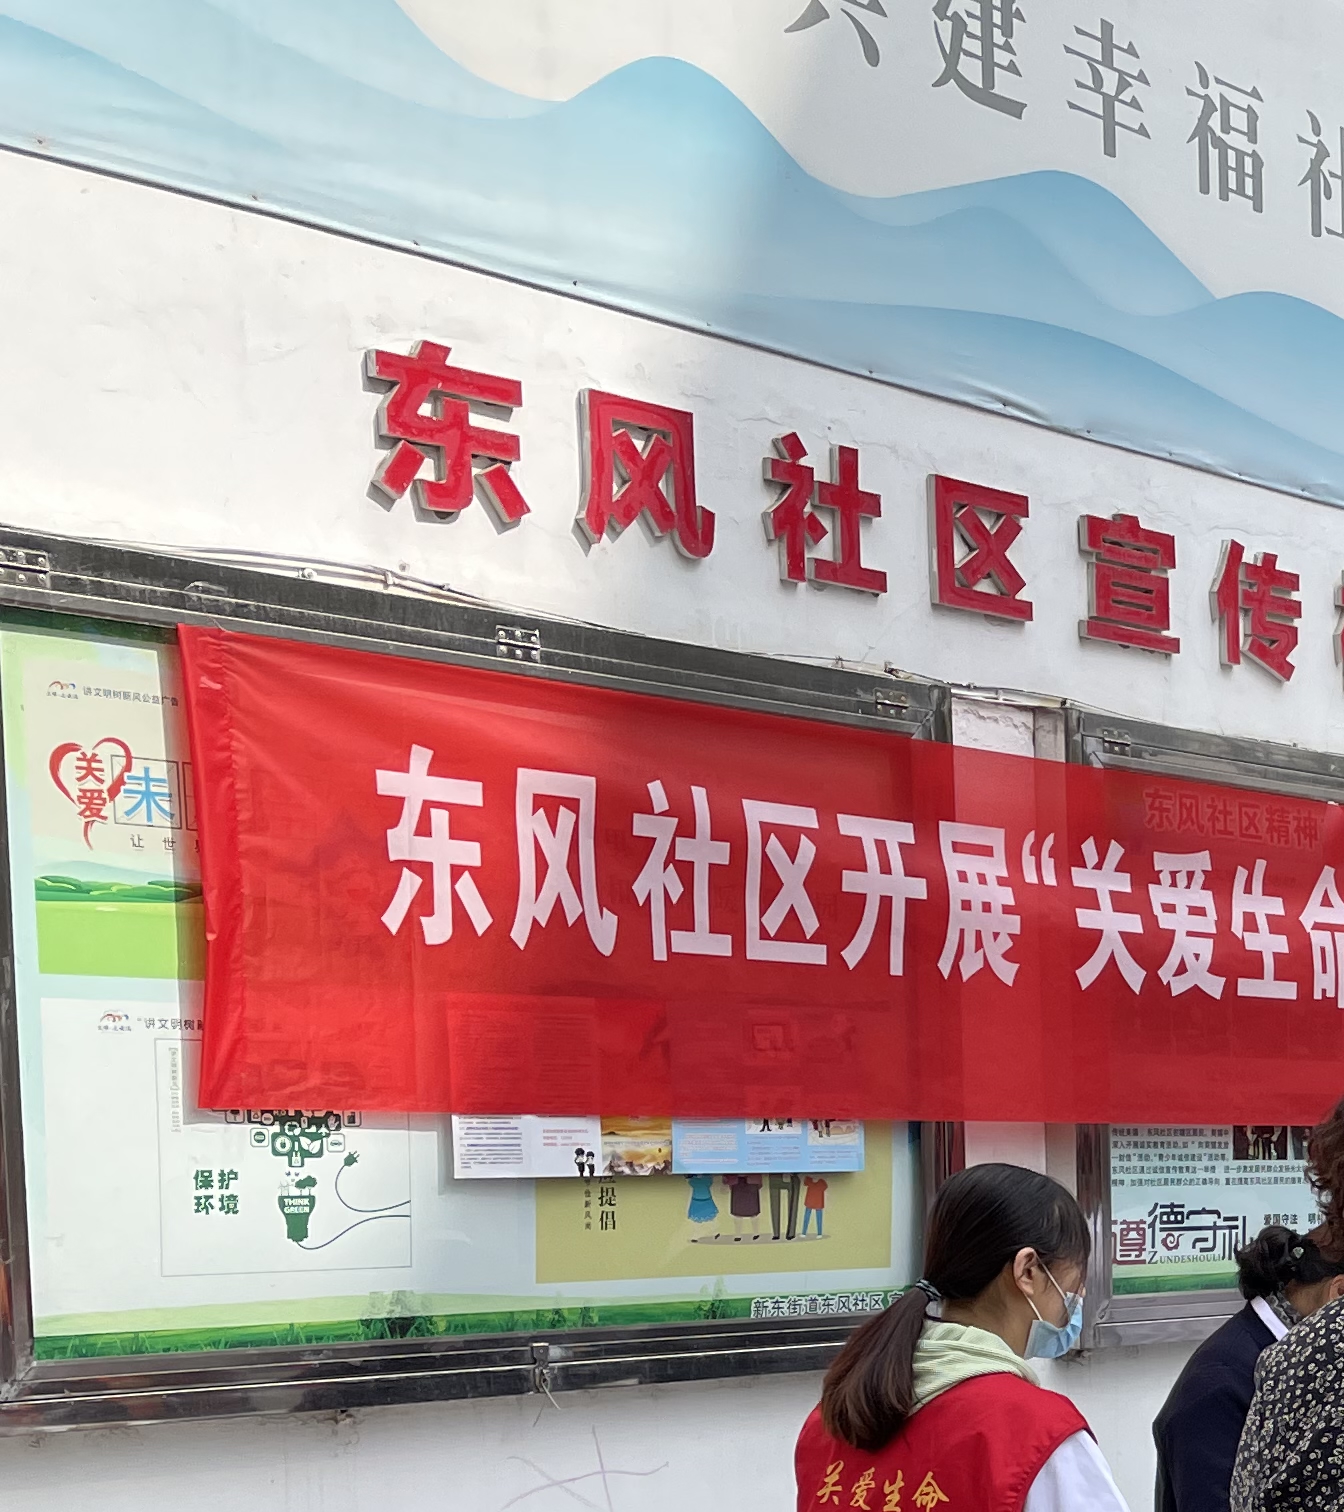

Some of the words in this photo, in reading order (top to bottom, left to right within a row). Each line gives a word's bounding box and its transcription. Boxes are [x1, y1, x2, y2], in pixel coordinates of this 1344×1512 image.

[75, 751, 108, 822] 关爱
[122, 766, 176, 824] 未
[193, 1168, 239, 1191] 保护
[193, 1194, 240, 1215] 环境
[752, 1294, 883, 1320] 新东街道东风社区
